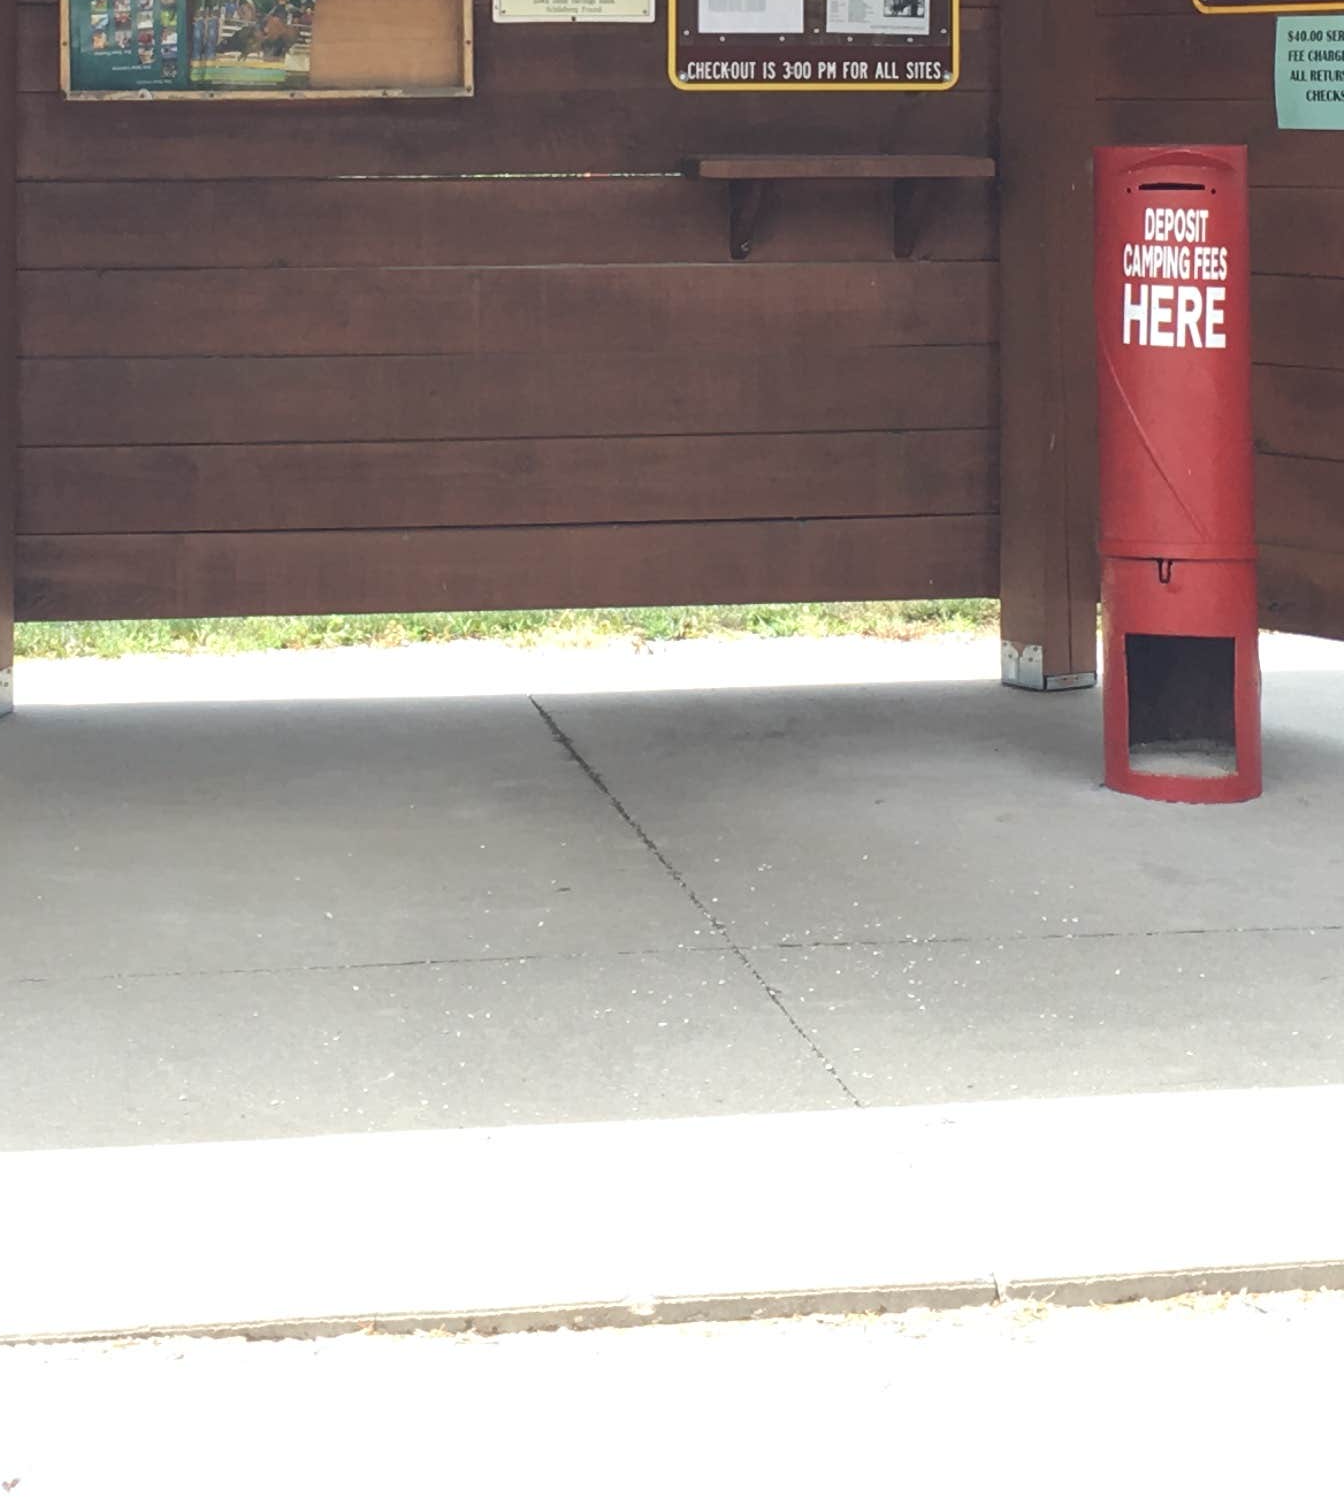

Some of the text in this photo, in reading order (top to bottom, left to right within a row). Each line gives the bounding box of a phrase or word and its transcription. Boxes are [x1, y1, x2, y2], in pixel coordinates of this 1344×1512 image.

[1288, 30, 1323, 42] $40.00
[1288, 50, 1305, 62] FEE
[762, 62, 776, 79] IS
[783, 62, 811, 79] 3:00
[818, 62, 836, 79] PM
[842, 62, 867, 79] FOR
[875, 62, 898, 79] ALL
[906, 62, 940, 79] SITES
[1290, 70, 1306, 82] ALL
[1144, 208, 1208, 242] DEPOSIT
[1123, 244, 1227, 280] CAMPING FEES
[1123, 283, 1227, 348] HERE
